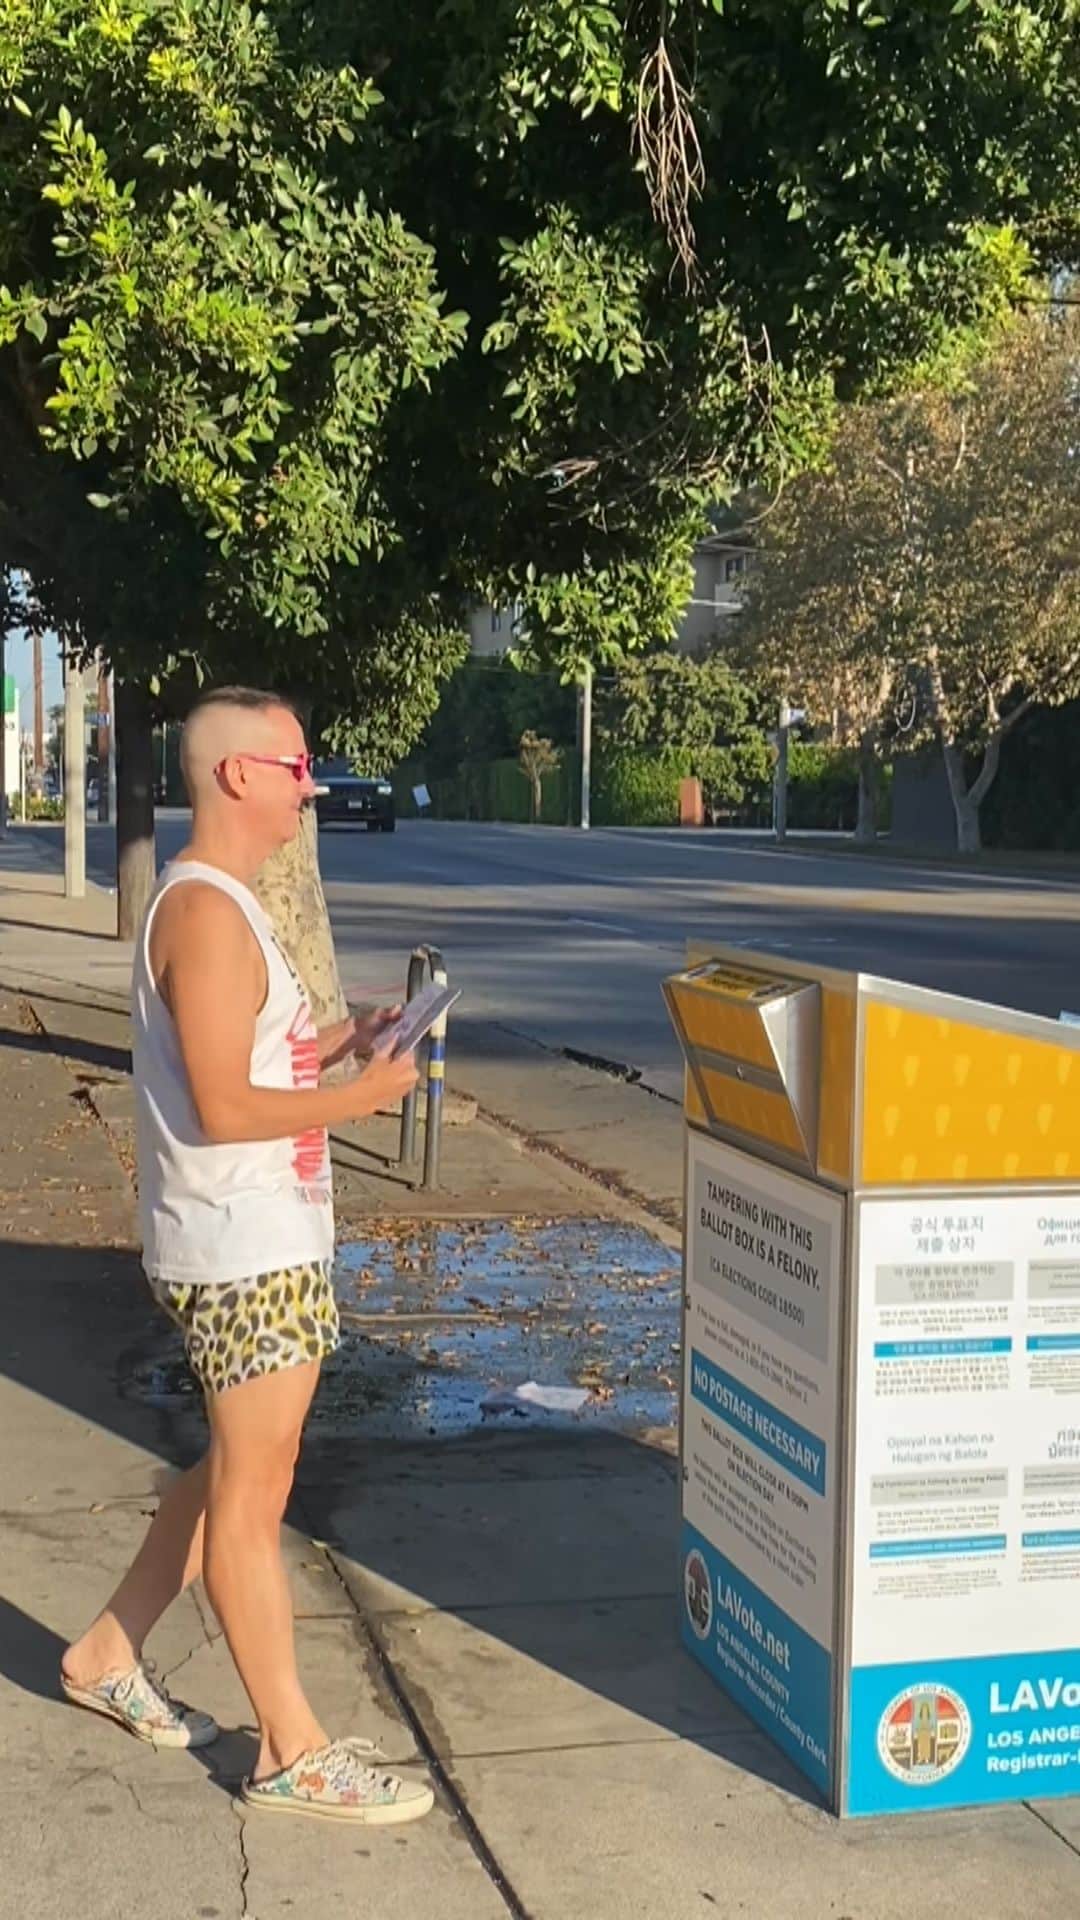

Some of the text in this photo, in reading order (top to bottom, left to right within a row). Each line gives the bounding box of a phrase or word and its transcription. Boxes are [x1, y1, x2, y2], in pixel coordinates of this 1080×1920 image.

[707, 1181, 813, 1252] TAMPERING WITH THIS
[701, 1208, 821, 1290] BALLOT BOX IS A FELONY.
[722, 1262, 758, 1297] ELECTIONS
[758, 1283, 777, 1309] CODE
[694, 1366, 710, 1394] NO
[710, 1377, 754, 1427] POSTAGE
[755, 1410, 820, 1476] NECESSARY
[713, 1427, 732, 1451] BALLOT
[736, 1464, 763, 1494] ELECTION
[717, 1576, 792, 1671] LAVote.net
[717, 1620, 791, 1704] LOS ANGELES COUNTY
[990, 1676, 1080, 1713] LAVo
[807, 1735, 828, 1767] Clerk
[987, 1724, 1080, 1749] LOS ANGE
